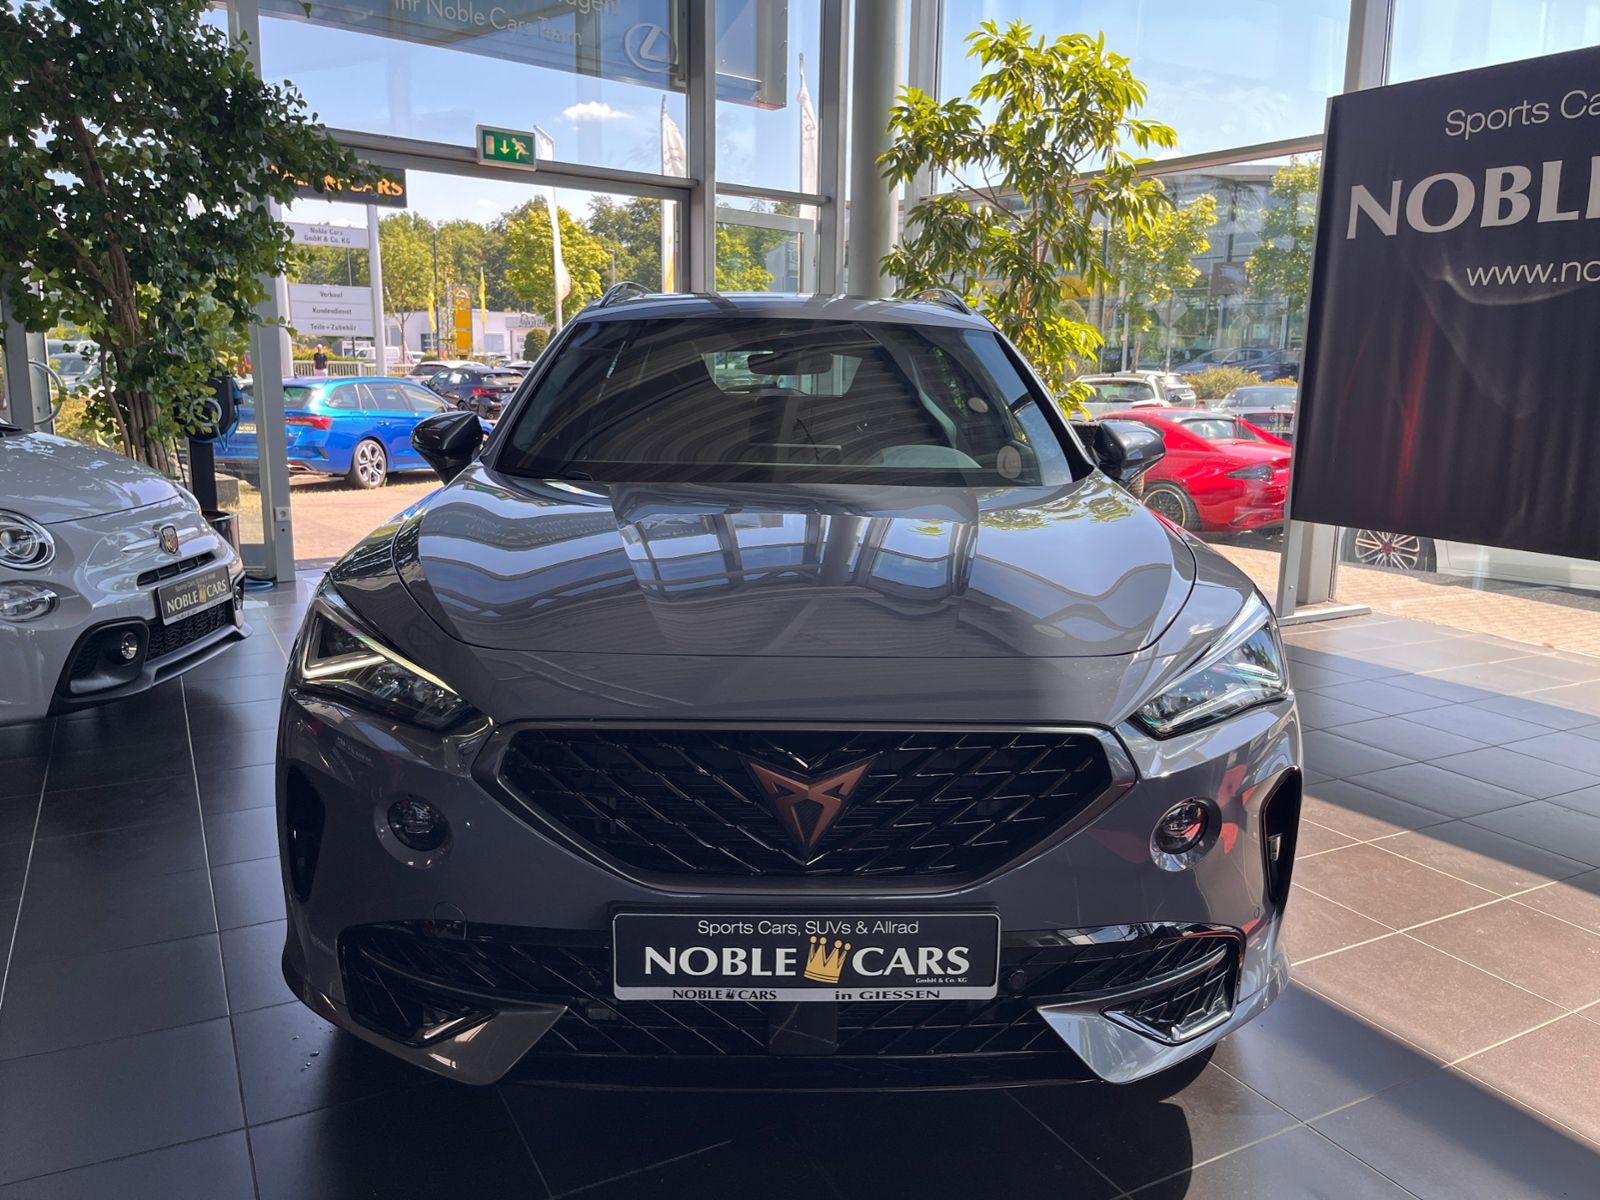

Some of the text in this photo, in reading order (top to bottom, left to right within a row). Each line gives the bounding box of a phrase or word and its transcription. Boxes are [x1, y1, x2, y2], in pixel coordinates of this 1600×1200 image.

[426, 0, 485, 26] Noble
[489, 7, 532, 34] Cars
[537, 16, 582, 46] Team
[1445, 99, 1550, 140] Sports
[304, 234, 322, 242] GmbH
[310, 227, 343, 236] Noble Cars
[320, 291, 343, 299] Verkauf
[166, 590, 199, 613] NOBLE
[206, 579, 227, 597] CARS
[697, 920, 919, 936] Sports Cars, SUVs & Allrad
[644, 946, 970, 976] NOBLE CARS
[672, 989, 940, 1000] NOBLE CARS in GIESSEN
